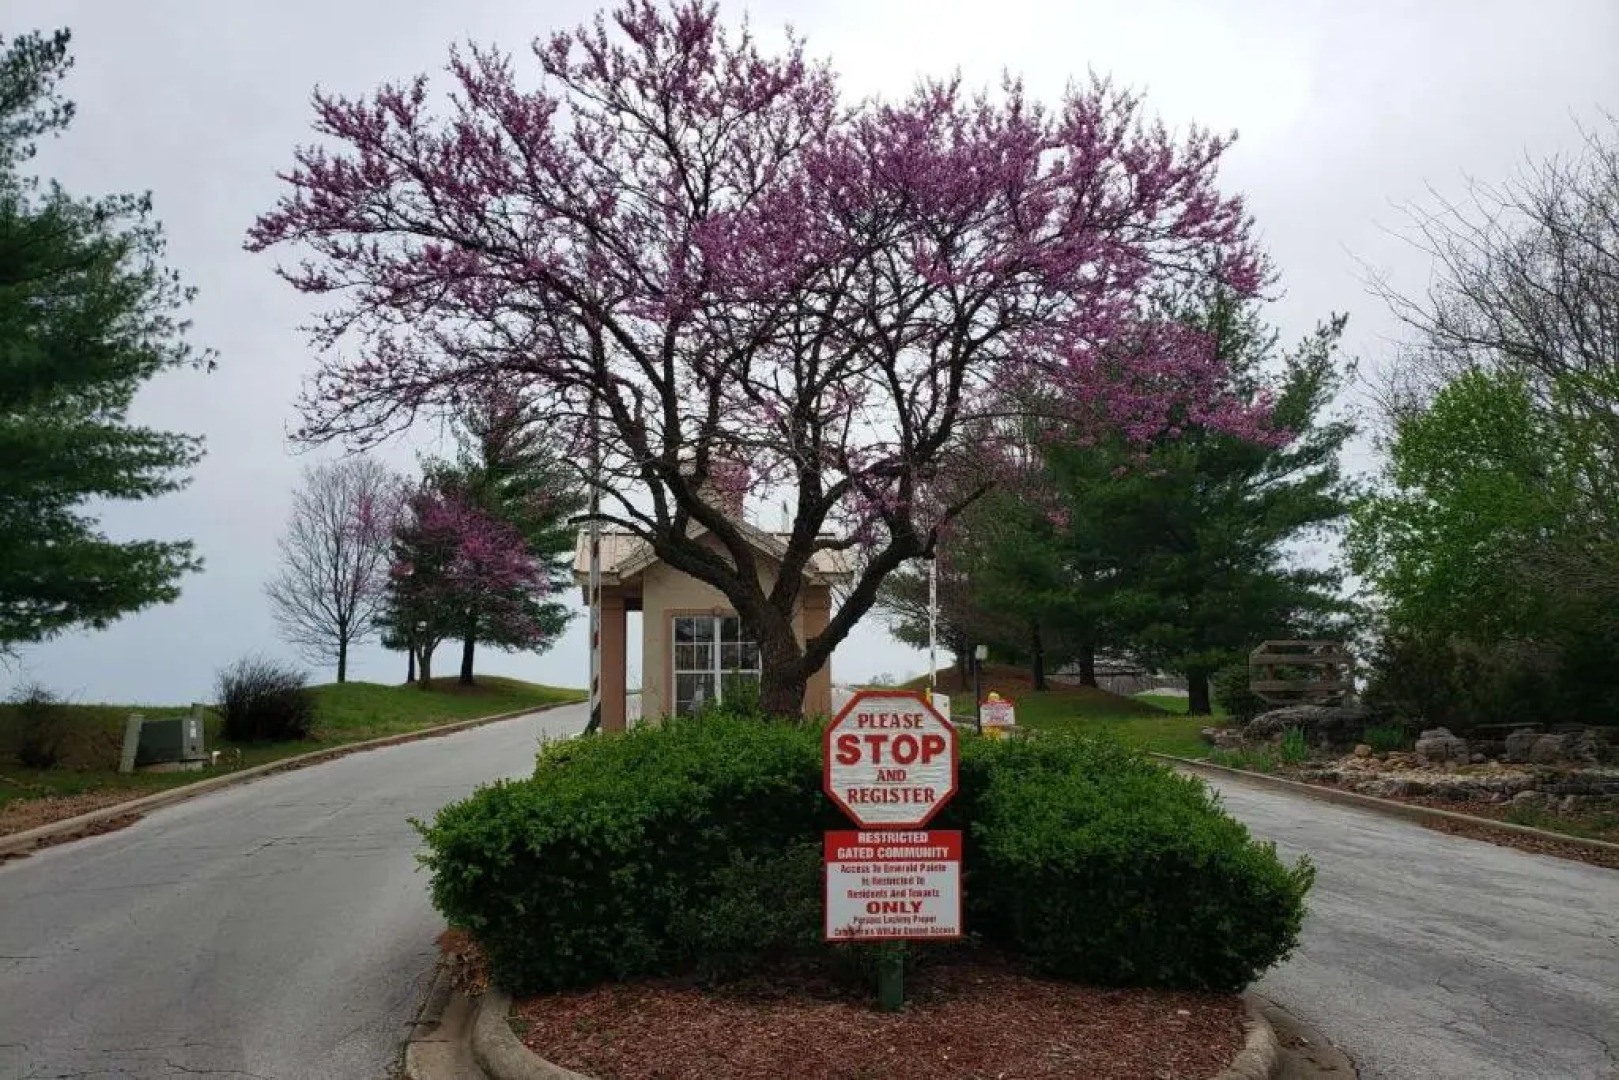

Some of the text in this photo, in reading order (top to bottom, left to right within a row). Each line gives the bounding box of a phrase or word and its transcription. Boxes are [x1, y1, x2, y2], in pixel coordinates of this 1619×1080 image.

[858, 713, 924, 729] PLEASE
[836, 734, 946, 765] STOP
[877, 769, 907, 781] AND
[847, 788, 935, 803] REGISTER
[858, 832, 929, 844] RESTRICTED
[837, 847, 949, 859] GATED COMMUNITY
[840, 864, 870, 873] Access
[866, 901, 923, 914] ONLY
